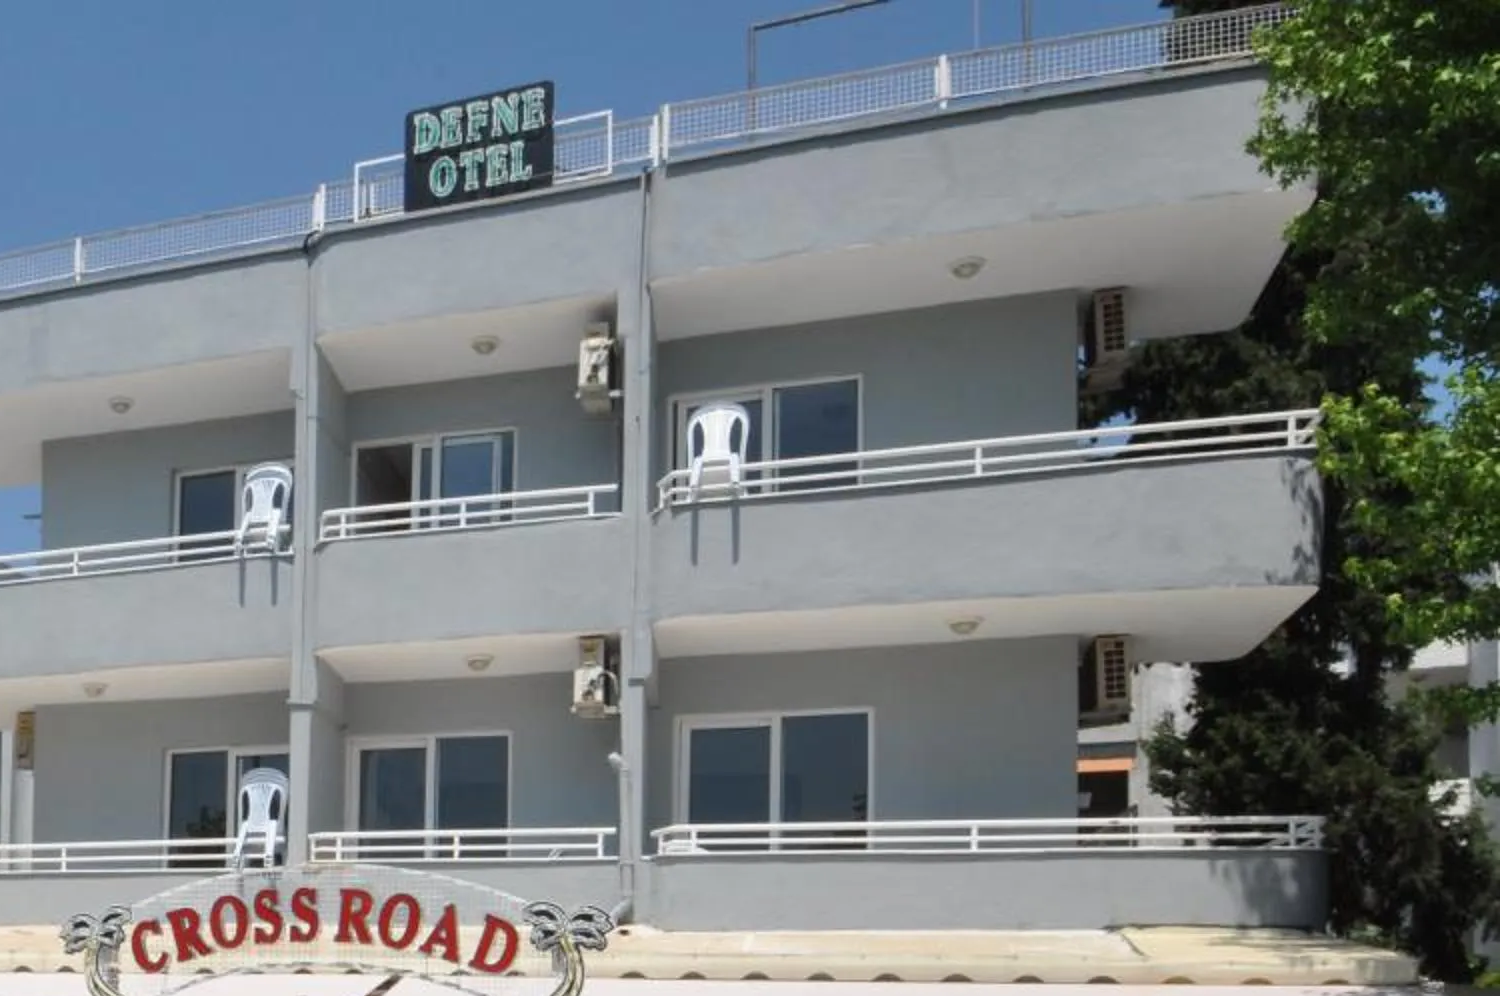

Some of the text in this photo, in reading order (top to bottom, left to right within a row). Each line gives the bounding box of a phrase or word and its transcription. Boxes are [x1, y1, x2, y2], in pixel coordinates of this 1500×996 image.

[413, 87, 546, 154] DEFNE
[429, 140, 532, 198] OTEL
[131, 887, 520, 974] CROSS ROAD
